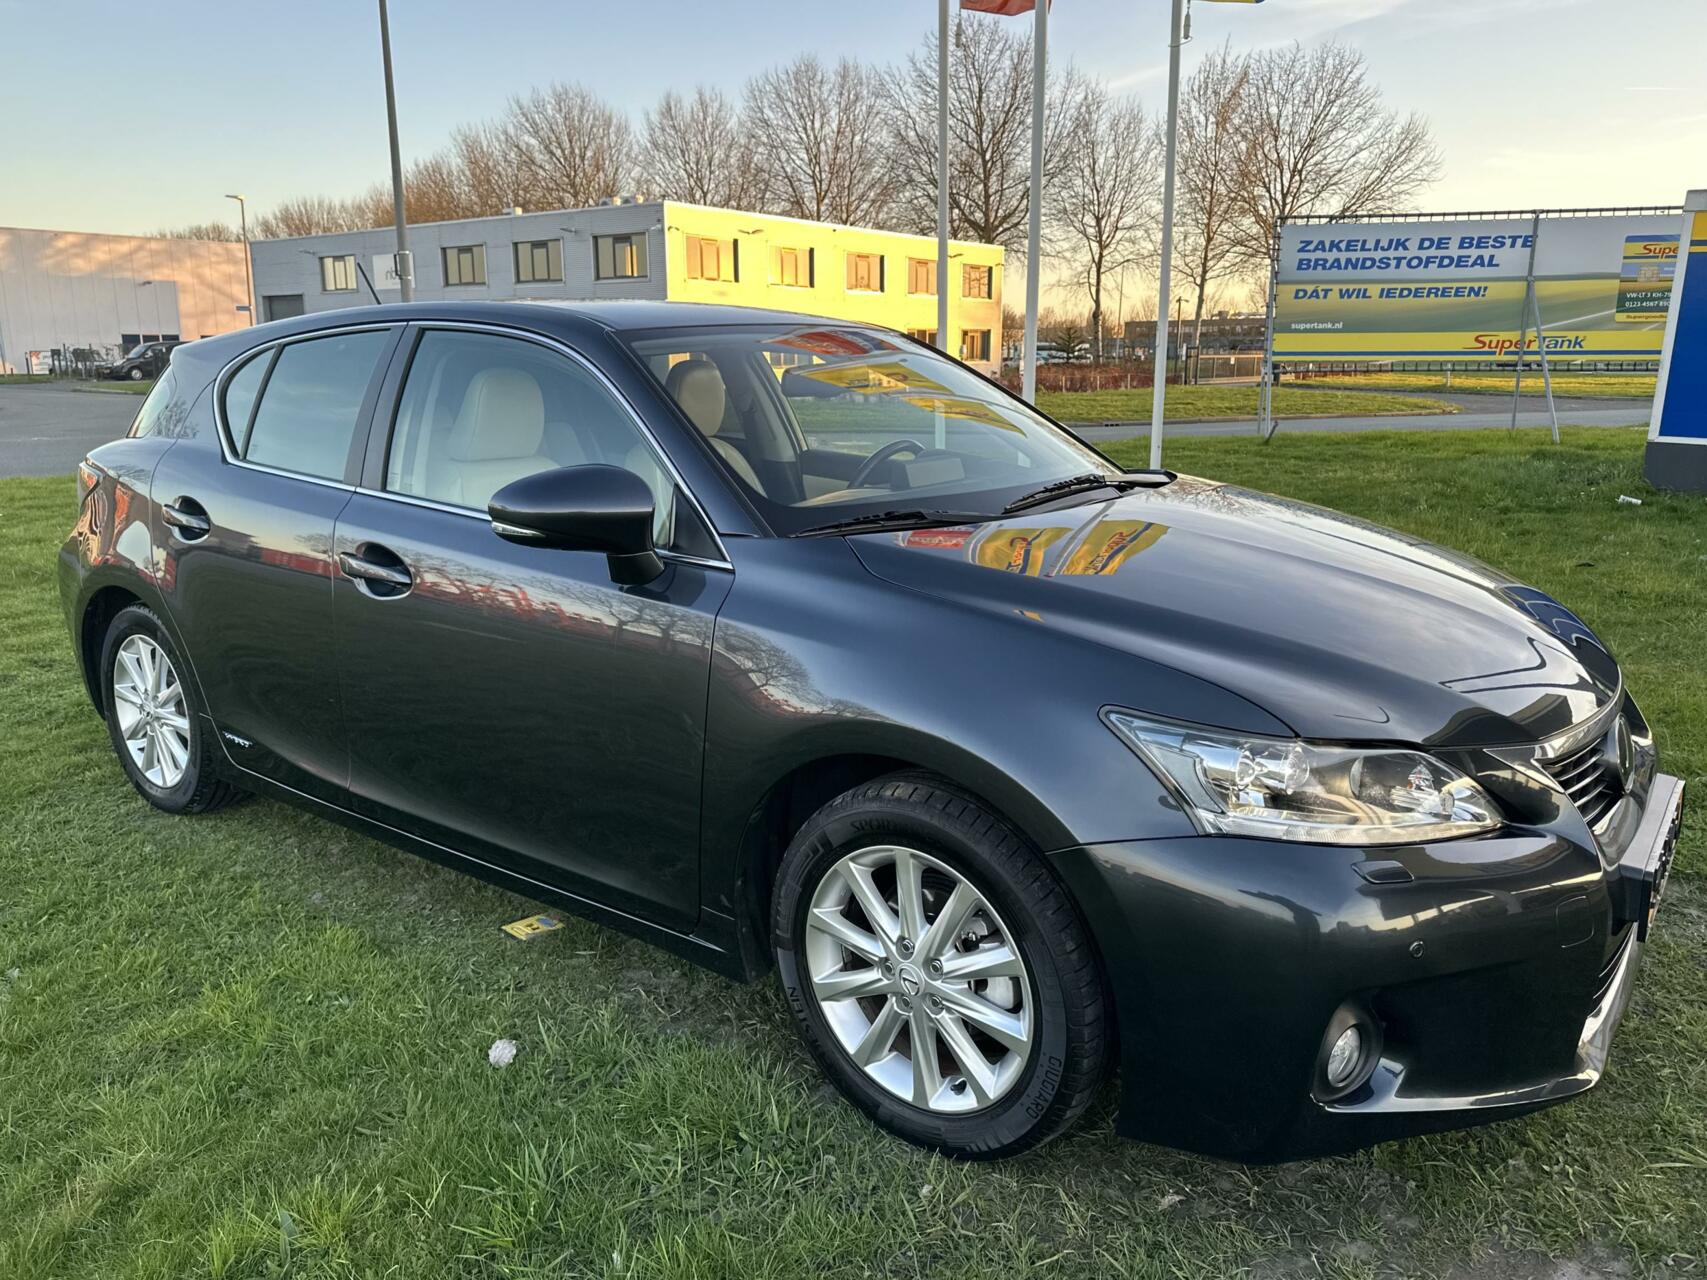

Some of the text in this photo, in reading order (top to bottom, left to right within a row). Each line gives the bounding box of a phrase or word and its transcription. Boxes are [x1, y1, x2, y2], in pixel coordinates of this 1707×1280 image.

[1297, 235, 1538, 253] ZAKELIJK DE BESTE
[1296, 255, 1500, 271] BRANDSTOFDEAL
[1293, 285, 1488, 300] DÁT WIL IEDEREEN!
[1291, 322, 1343, 330] supertank.nl
[1025, 1055, 1063, 1119] GIUGIARO
